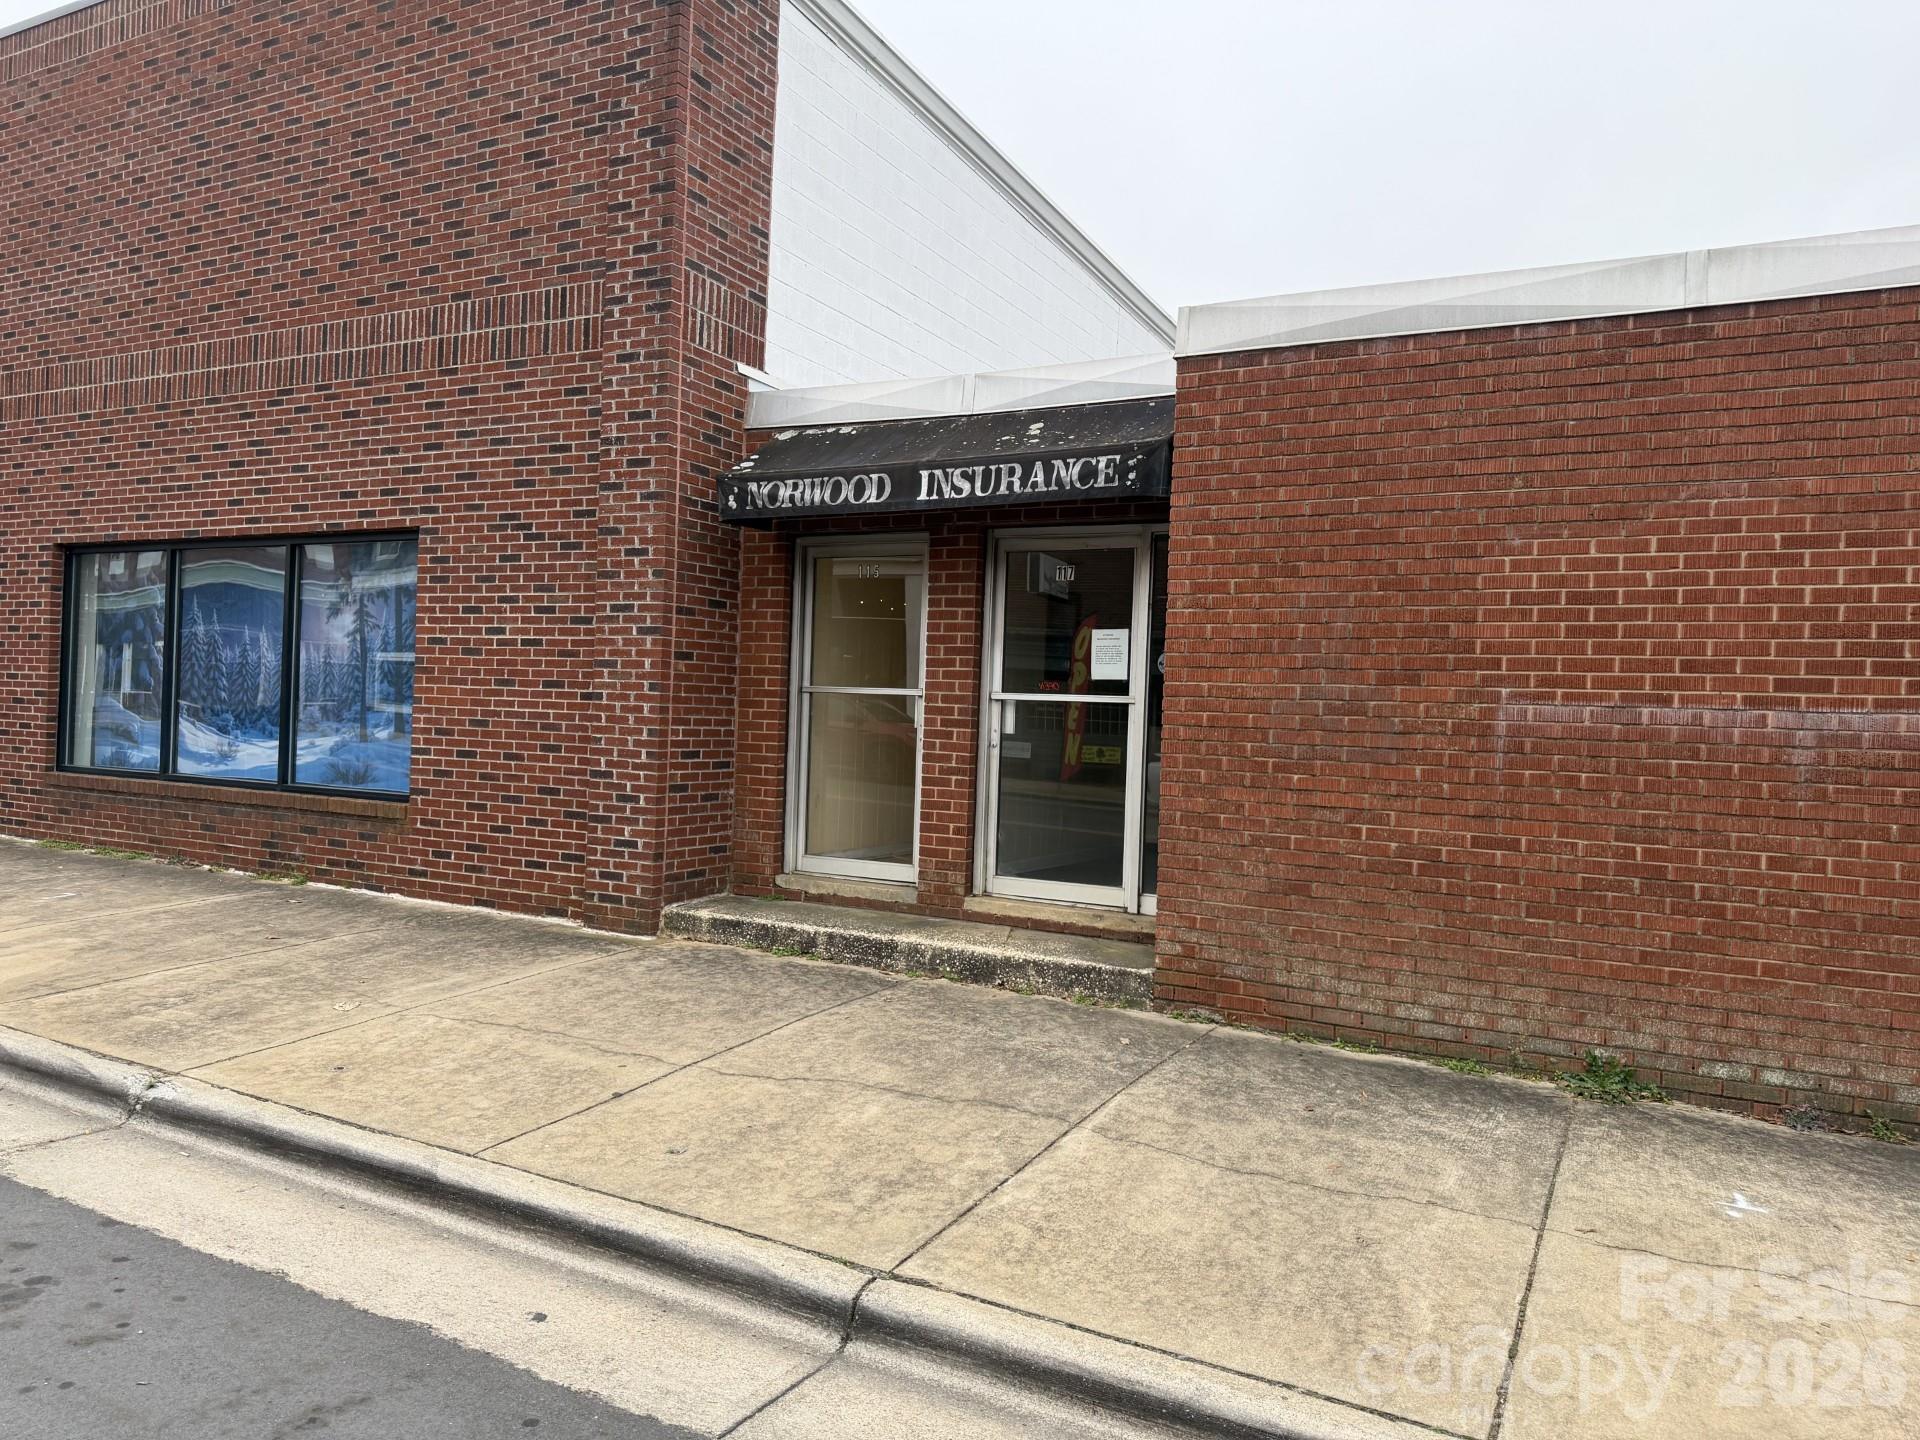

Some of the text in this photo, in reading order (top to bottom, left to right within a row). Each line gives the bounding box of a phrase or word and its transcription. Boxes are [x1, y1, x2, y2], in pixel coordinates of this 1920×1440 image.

[746, 454, 1120, 510] NORWOOD INSURANCE
[858, 565, 880, 579] 115
[1057, 566, 1074, 580] 117
[1065, 626, 1090, 766] OPEN
